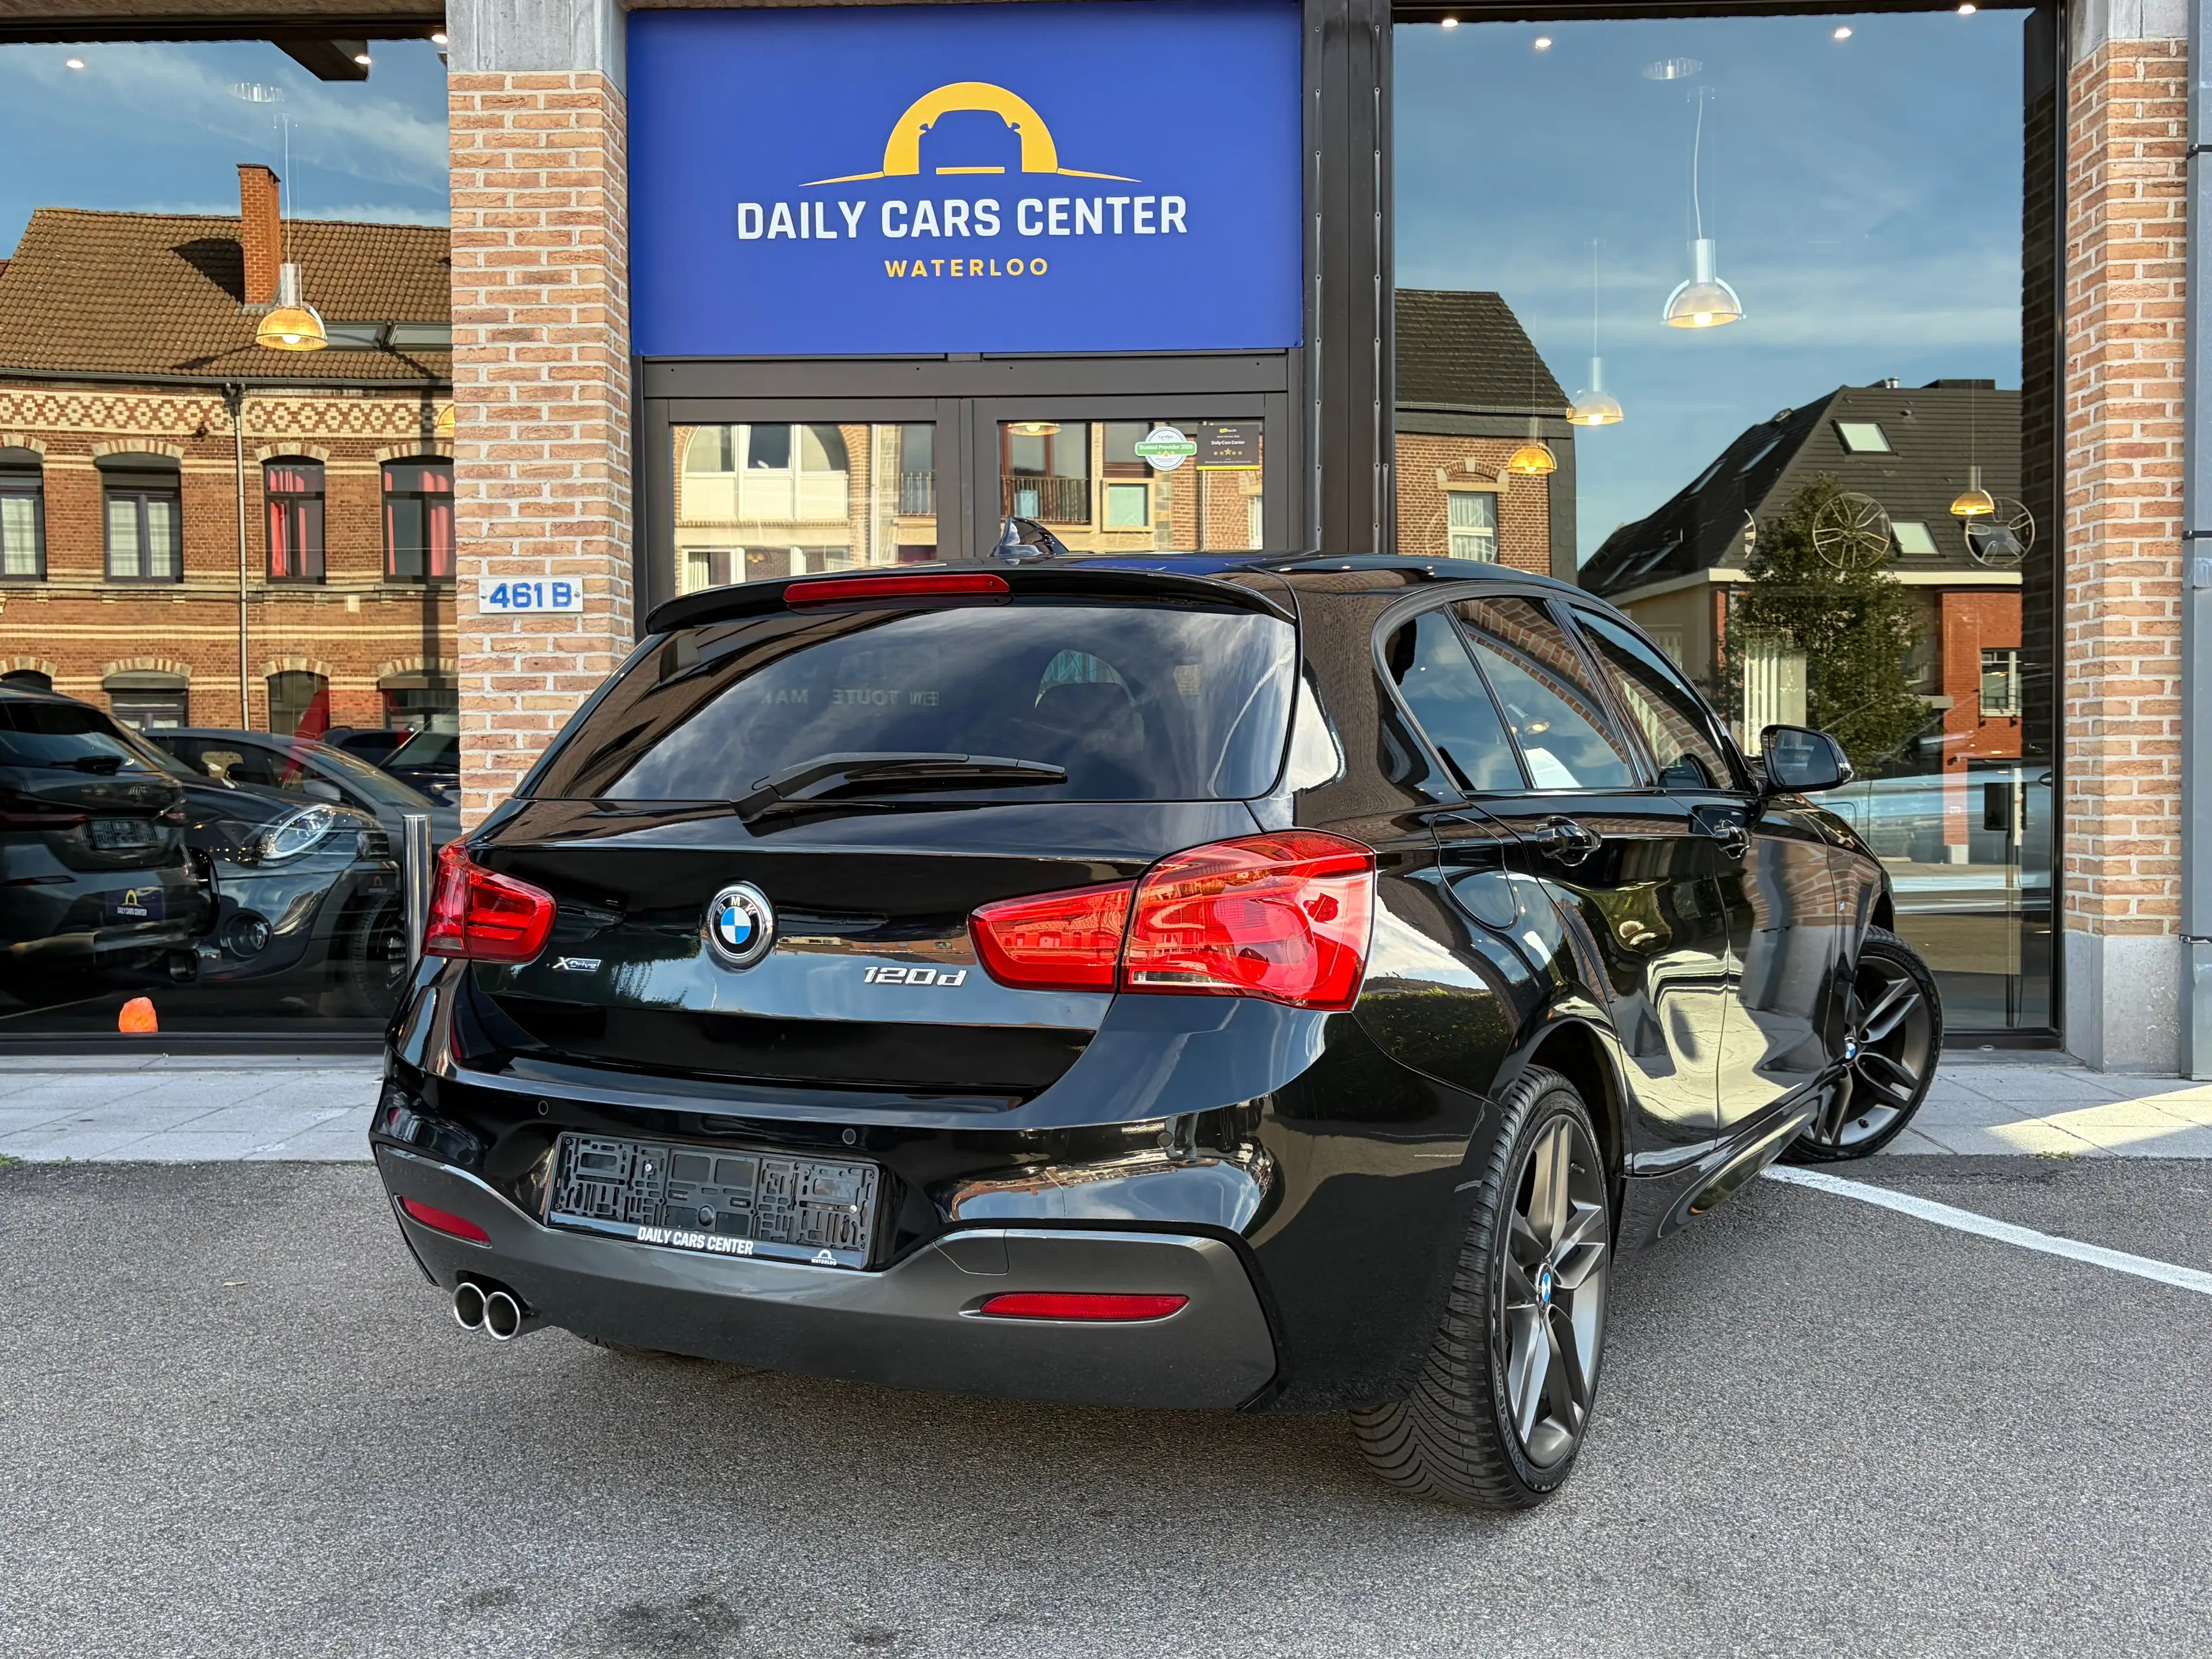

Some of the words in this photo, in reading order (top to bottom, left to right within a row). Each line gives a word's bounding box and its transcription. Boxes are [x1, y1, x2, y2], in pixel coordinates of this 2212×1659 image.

[738, 202, 867, 240] DAILY
[881, 199, 1001, 238] CARS
[1017, 196, 1187, 236] CENTER
[884, 258, 1048, 278] WATERLOO
[490, 582, 543, 608] 461
[552, 582, 572, 608] B
[717, 896, 757, 916] BMW
[864, 966, 968, 986] 120d
[637, 1226, 672, 1244] DAILY
[673, 1232, 706, 1249] CARS
[707, 1236, 755, 1255] CENTER
[811, 1258, 837, 1266] WATERLOO
[1502, 1417, 1524, 1472] SOLUS
